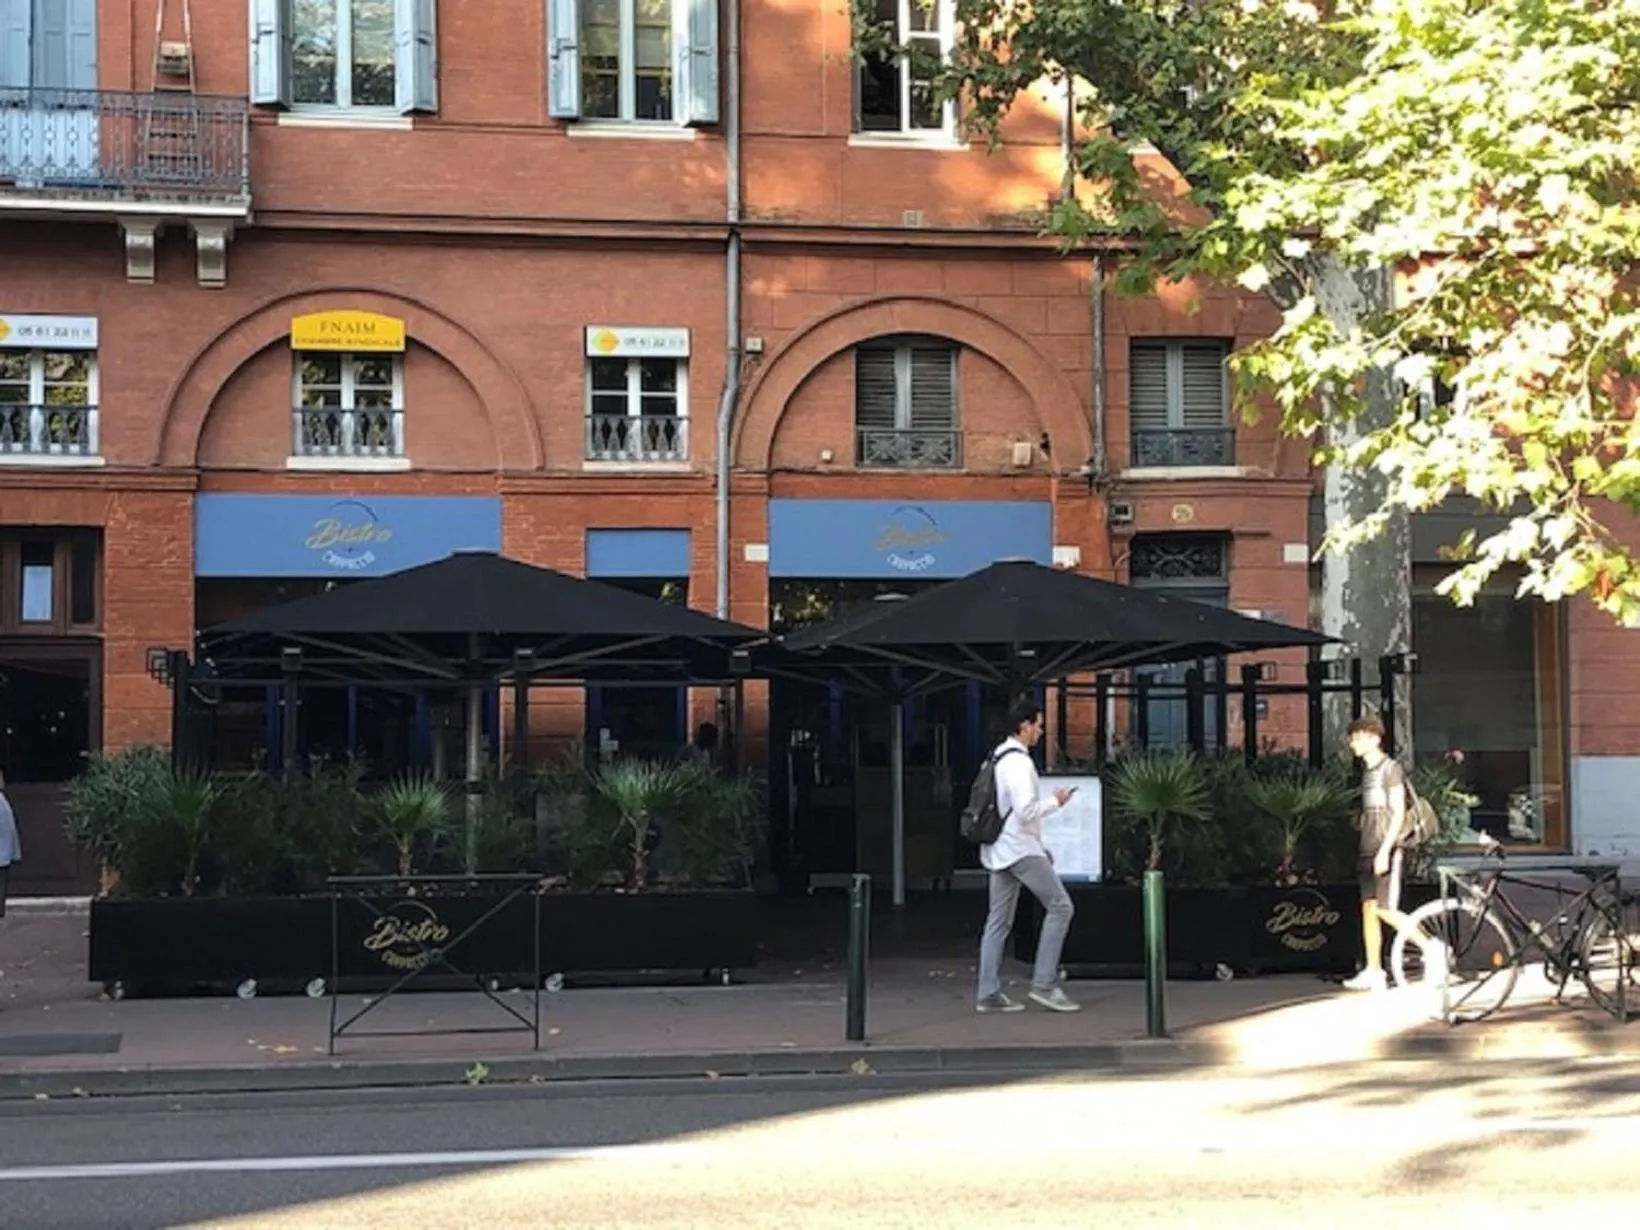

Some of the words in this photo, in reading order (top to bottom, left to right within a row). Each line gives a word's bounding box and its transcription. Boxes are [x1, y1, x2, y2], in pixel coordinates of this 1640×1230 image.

[319, 320, 376, 335] FNAIM
[304, 518, 393, 549] Bistro
[363, 915, 449, 950] Bistro
[1265, 901, 1341, 933] Bistro
